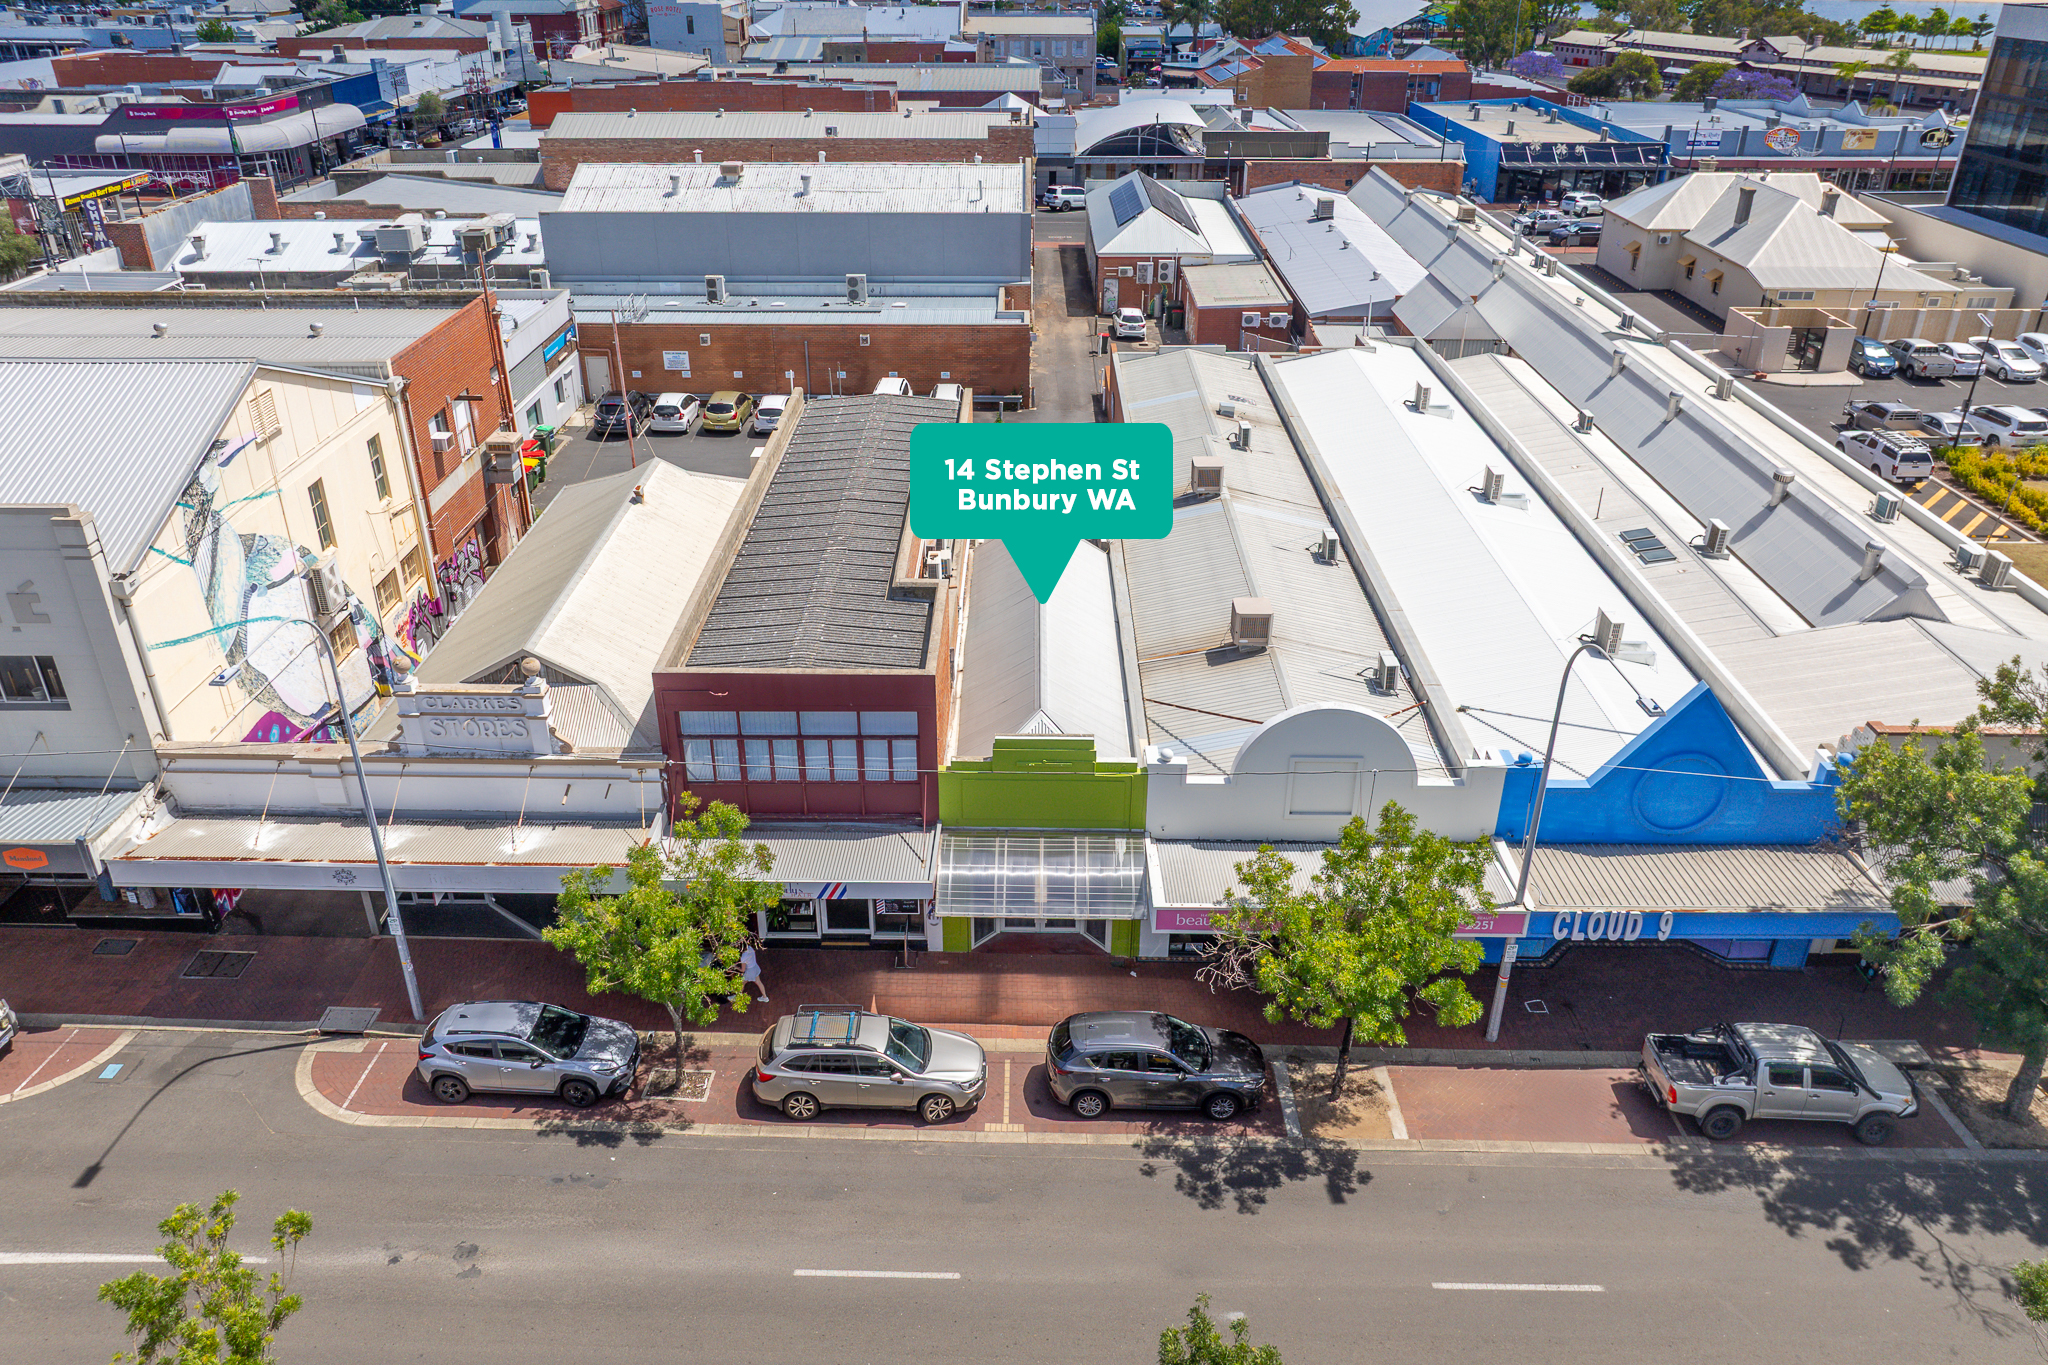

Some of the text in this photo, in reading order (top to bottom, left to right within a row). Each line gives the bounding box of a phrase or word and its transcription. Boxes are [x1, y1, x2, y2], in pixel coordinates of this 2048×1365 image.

[650, 5, 682, 14] ROSE HOTEL
[64, 184, 122, 206] Down South Surf Shop
[421, 696, 523, 711] CLARKES
[430, 718, 530, 739] STORES
[1552, 910, 1674, 942] CLOUD 9
